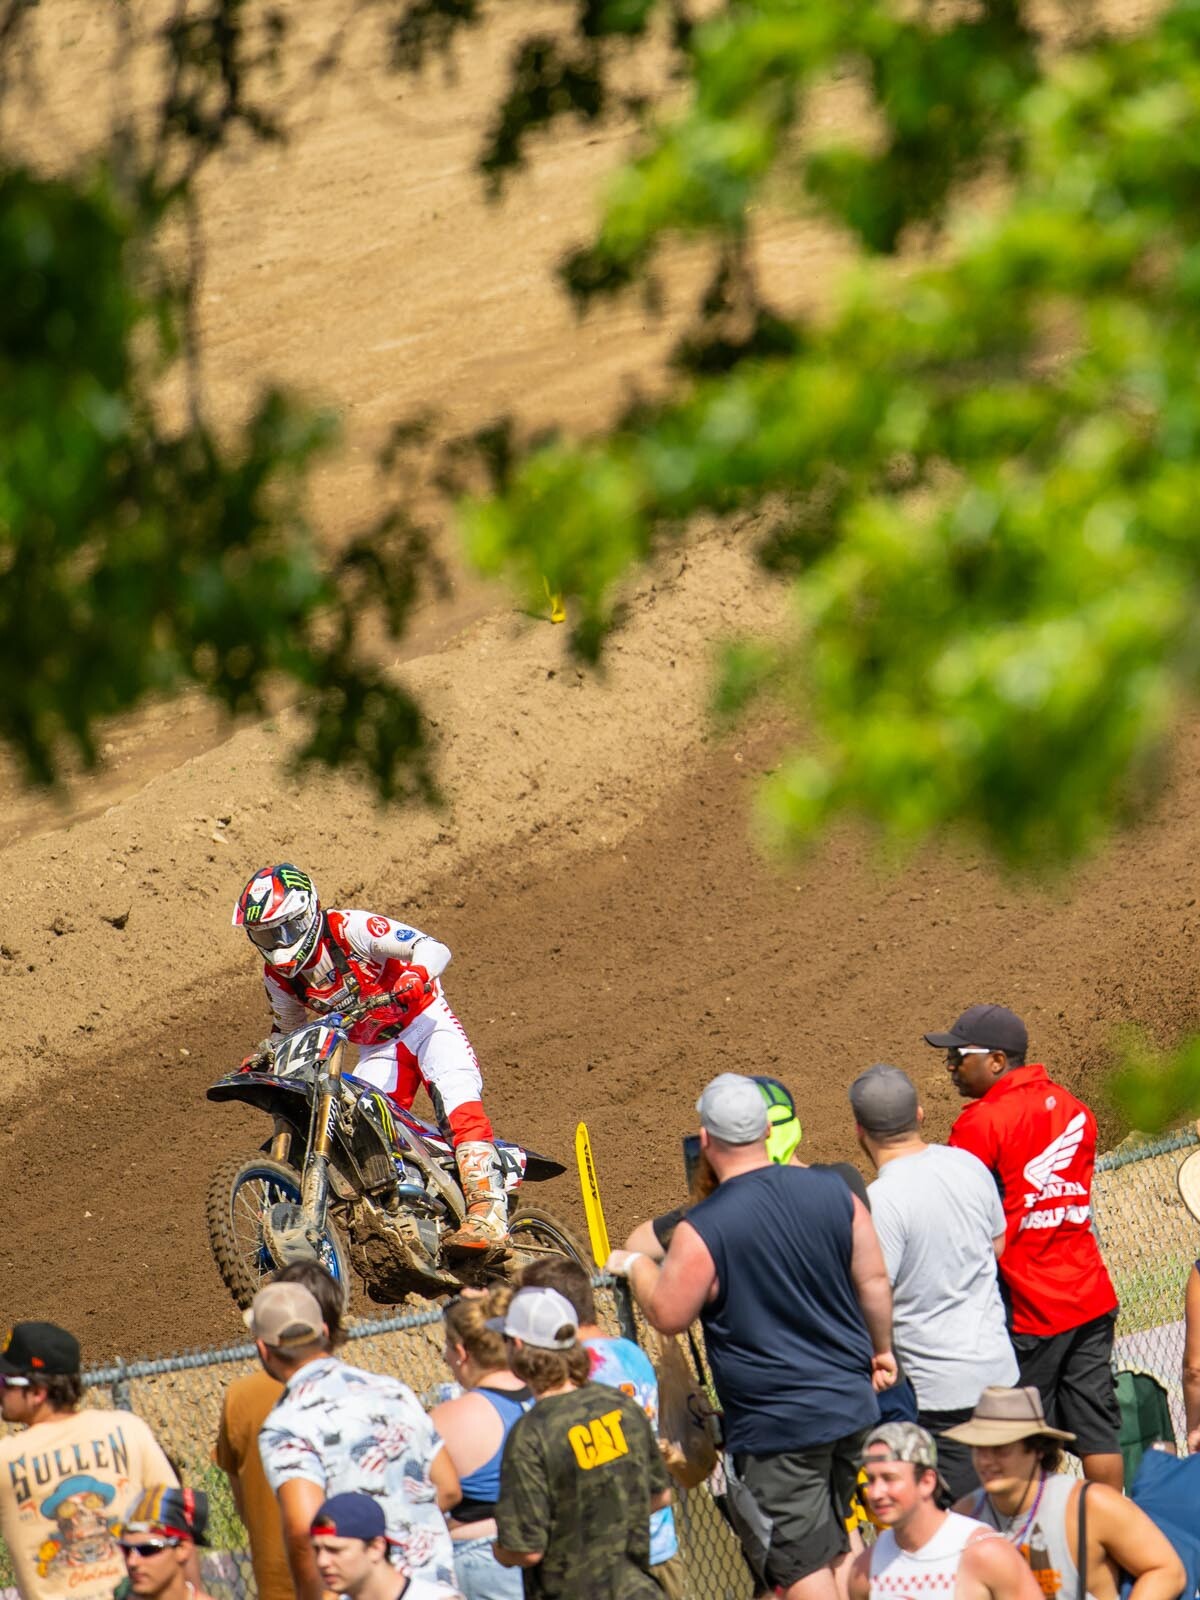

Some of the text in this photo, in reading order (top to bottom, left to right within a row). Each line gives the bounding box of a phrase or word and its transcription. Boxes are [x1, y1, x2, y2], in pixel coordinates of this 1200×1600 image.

[370, 916, 388, 937] 68
[276, 1026, 322, 1072] 14
[8, 1425, 130, 1502] SULLEN
[567, 1409, 629, 1471] CAT
